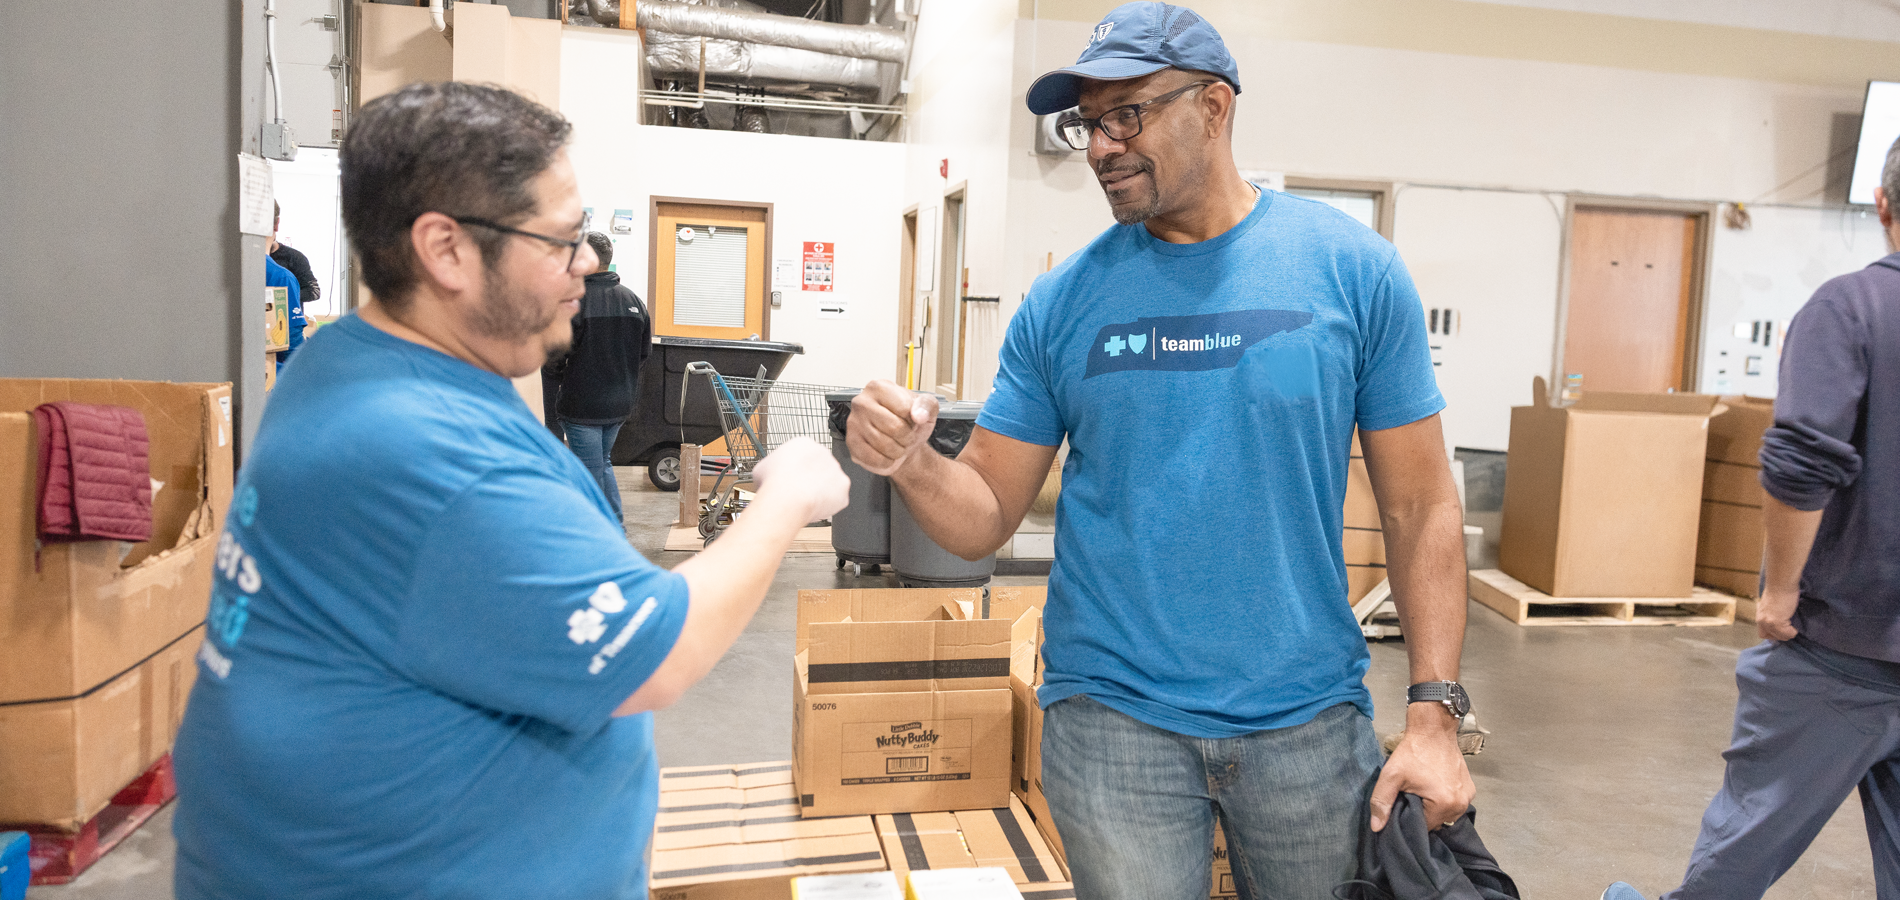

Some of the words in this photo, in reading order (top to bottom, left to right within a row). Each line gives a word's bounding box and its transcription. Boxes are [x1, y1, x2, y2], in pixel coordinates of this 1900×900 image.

[1161, 332, 1242, 352] teamblue
[812, 702, 837, 711] 50076
[876, 734, 907, 748] Nutty
[908, 729, 939, 745] Buddy
